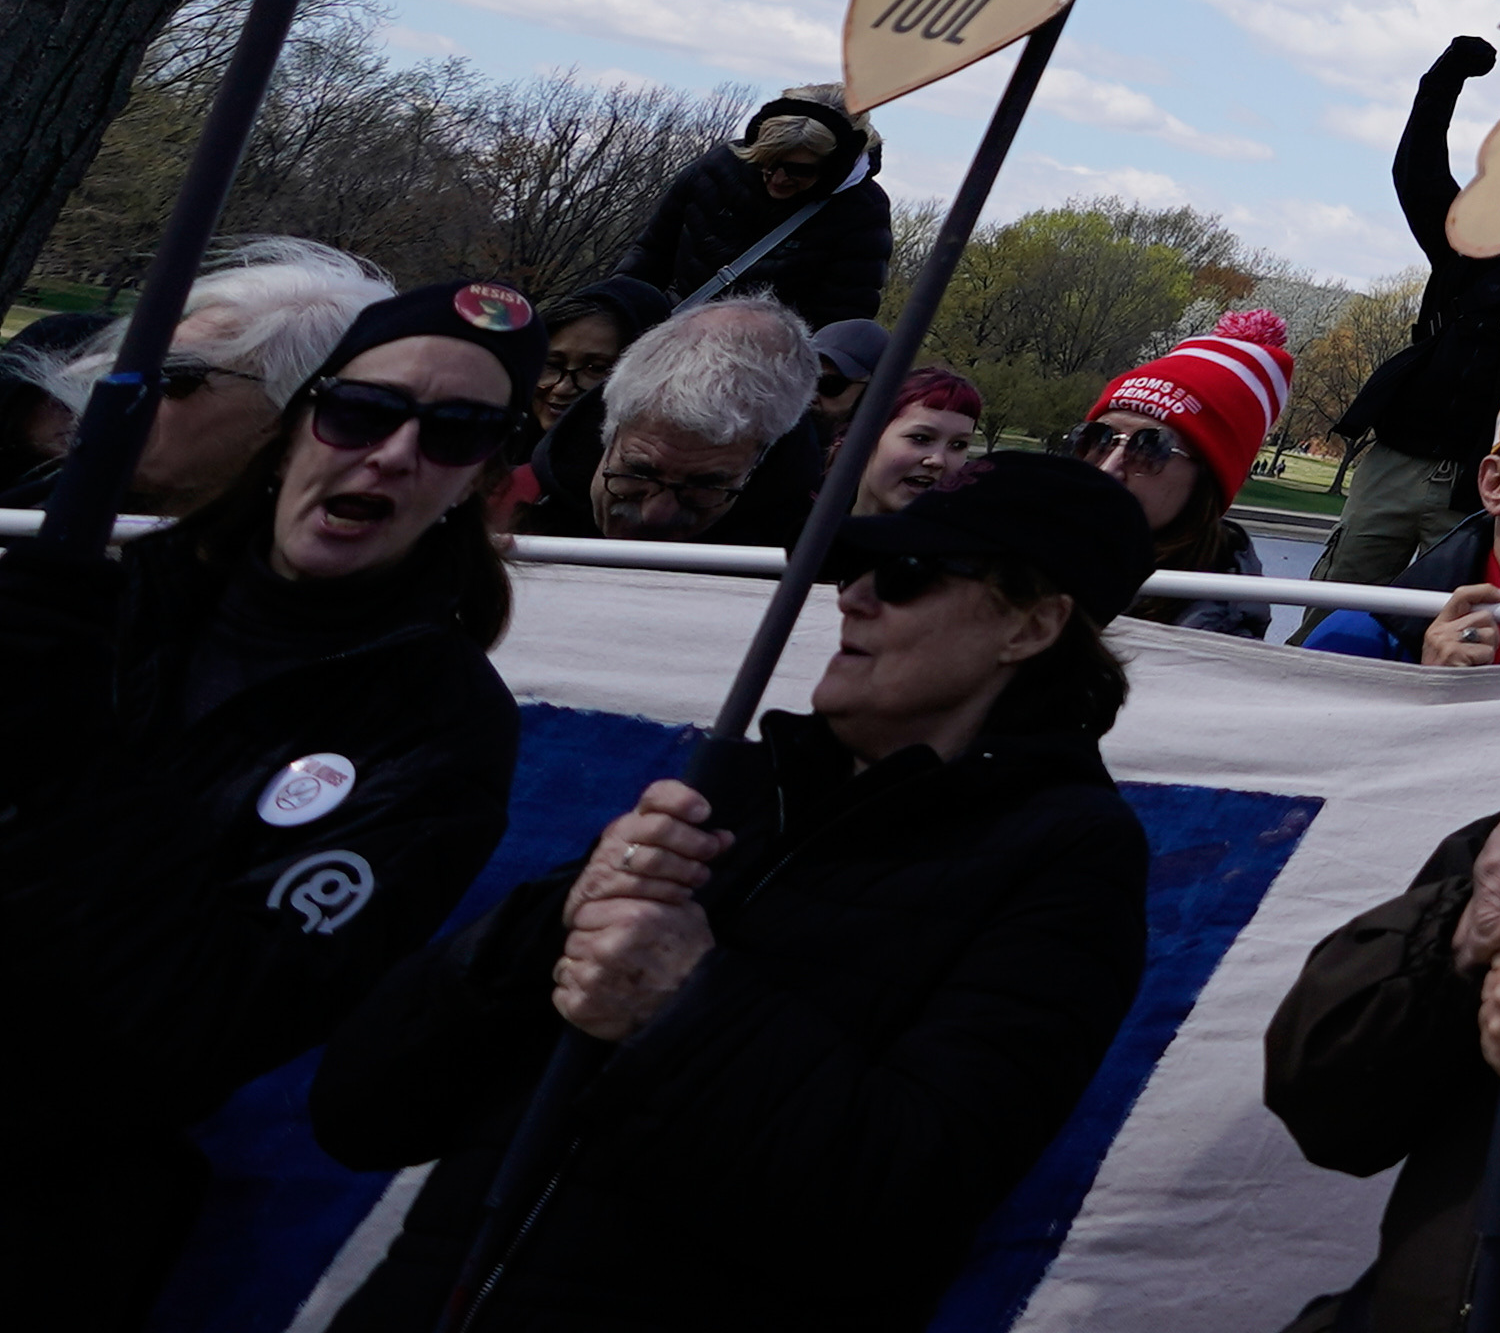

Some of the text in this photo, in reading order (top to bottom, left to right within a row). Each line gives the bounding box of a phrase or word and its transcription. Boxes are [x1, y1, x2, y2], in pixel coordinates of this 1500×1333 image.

[469, 283, 522, 306] RESIST
[1121, 377, 1174, 393] MOMS
[1109, 399, 1170, 420] ACTION
[1112, 387, 1185, 414] DEMAND
